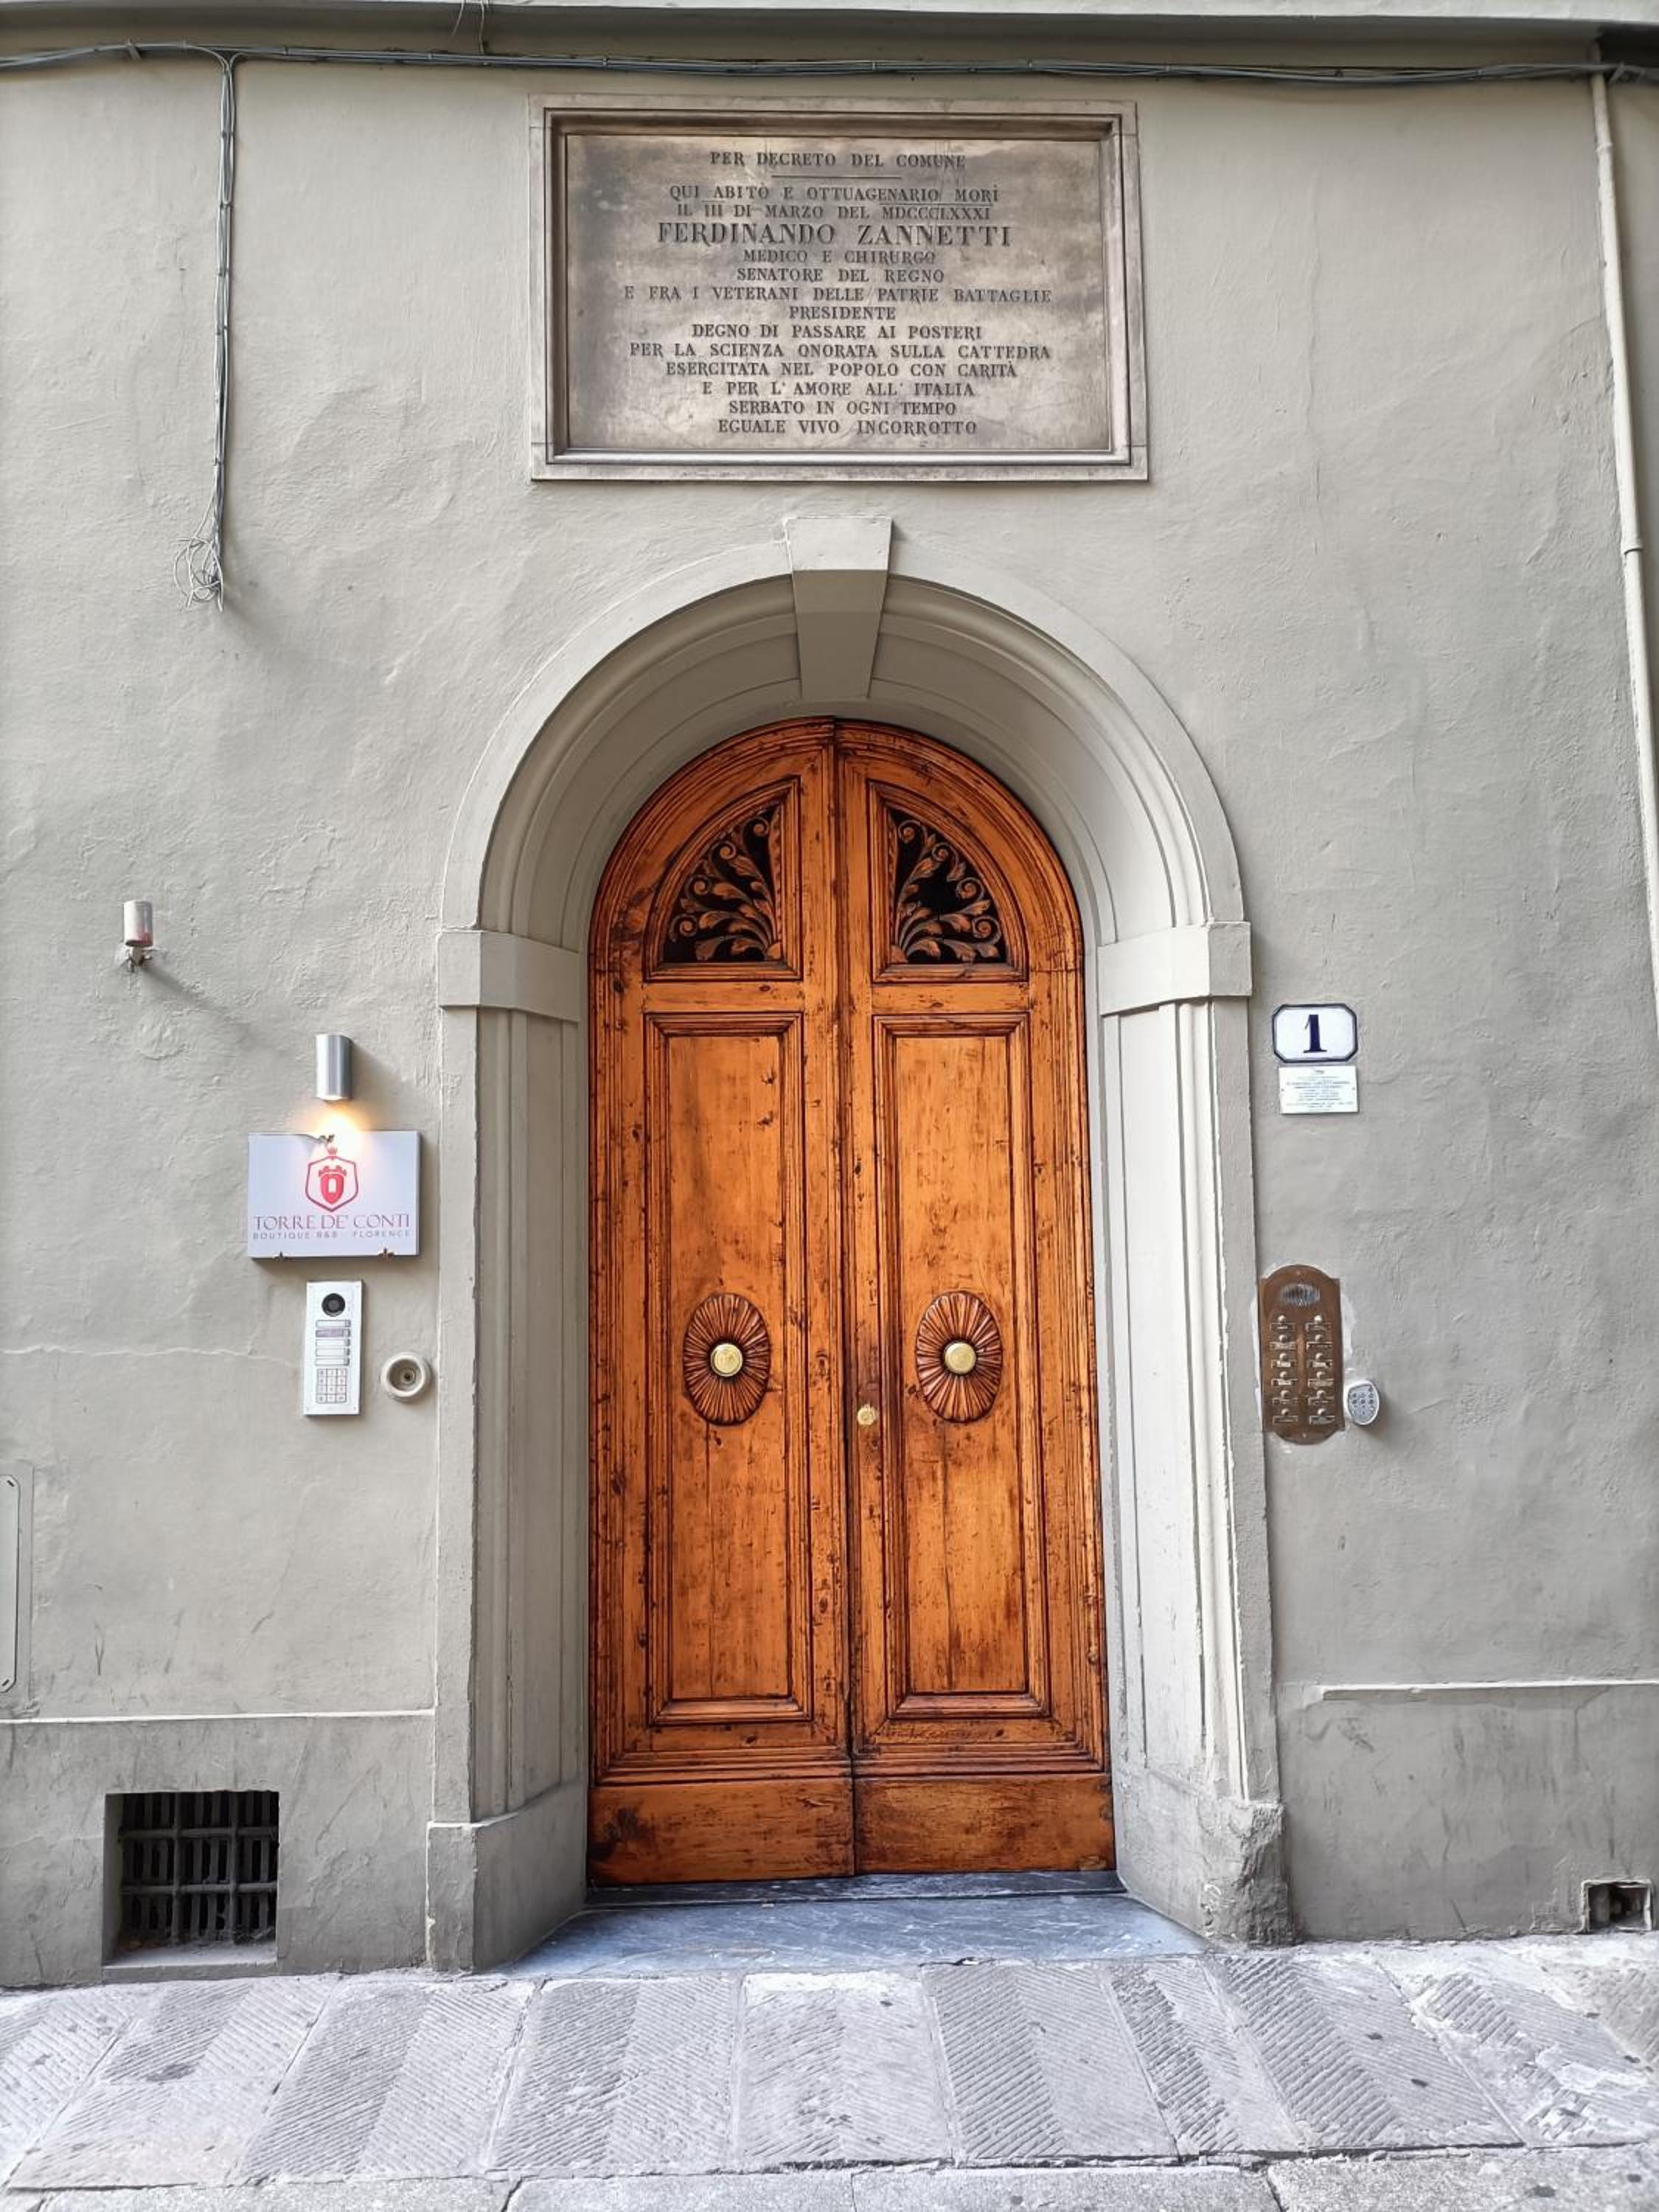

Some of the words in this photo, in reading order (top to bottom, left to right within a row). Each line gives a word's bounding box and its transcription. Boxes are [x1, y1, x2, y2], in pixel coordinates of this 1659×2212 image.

[710, 151, 745, 167] PER
[757, 152, 835, 167] DECRETO
[852, 153, 884, 167] DEL
[896, 154, 966, 168] COMUNE
[669, 185, 699, 201] QUI
[714, 182, 768, 199] ABITÒ
[783, 187, 793, 199] E
[807, 187, 939, 203] OTTUAGENARIO
[678, 204, 692, 217] IL
[704, 204, 723, 218] III
[734, 204, 751, 218] DI
[765, 206, 823, 219] MARZO
[838, 206, 870, 219] DEL
[882, 206, 990, 220] MDCCCLXXXI
[658, 222, 835, 246] FERDINANDO
[858, 224, 1011, 247] ZANNETTI
[743, 250, 807, 263] MEDICO
[823, 250, 832, 263] E
[844, 251, 936, 265] CHIRURGO
[737, 268, 823, 283] SENATORE
[838, 269, 869, 282] DEL
[884, 269, 944, 283] REGNO
[625, 286, 634, 299] E
[649, 286, 681, 302] FRA
[692, 286, 700, 299] I
[712, 287, 799, 302] VETERANI
[813, 288, 864, 302] DELLE
[877, 288, 939, 305] PATRIE
[954, 289, 1051, 303] BATTAGLIE
[789, 306, 896, 320] PRESIDENTE
[692, 324, 749, 338] DEGNO
[761, 324, 779, 338] DI
[791, 325, 866, 340] PASSARE
[877, 325, 896, 339] AI
[908, 325, 982, 341] POSTERI
[630, 342, 664, 358] PER
[675, 343, 696, 357] LA
[710, 343, 784, 358] SCIENZA
[798, 344, 877, 359] ONORATA
[890, 345, 945, 359] SULLA
[958, 345, 1050, 361] CATTEDRA
[667, 362, 769, 377] ESERCITATA
[781, 363, 814, 376] NEL
[829, 363, 898, 377] POPOLO
[911, 364, 947, 377] CON
[958, 361, 1018, 379] CARITÀ
[703, 382, 712, 394] E
[726, 381, 759, 397] PER
[728, 400, 804, 415] SERBATO
[816, 401, 835, 414] IN
[846, 401, 890, 415] OGNI
[900, 402, 956, 415] TEMPO
[717, 420, 786, 434] EGUALE
[799, 420, 839, 434] VIVO
[858, 420, 978, 437] INCORROTTO
[1303, 1014, 1327, 1054] 1
[253, 1214, 316, 1231] TORRE
[353, 1214, 410, 1228] CONTI
[253, 1231, 310, 1239] BOUTIQUE
[353, 1229, 410, 1239] FLORENCE
